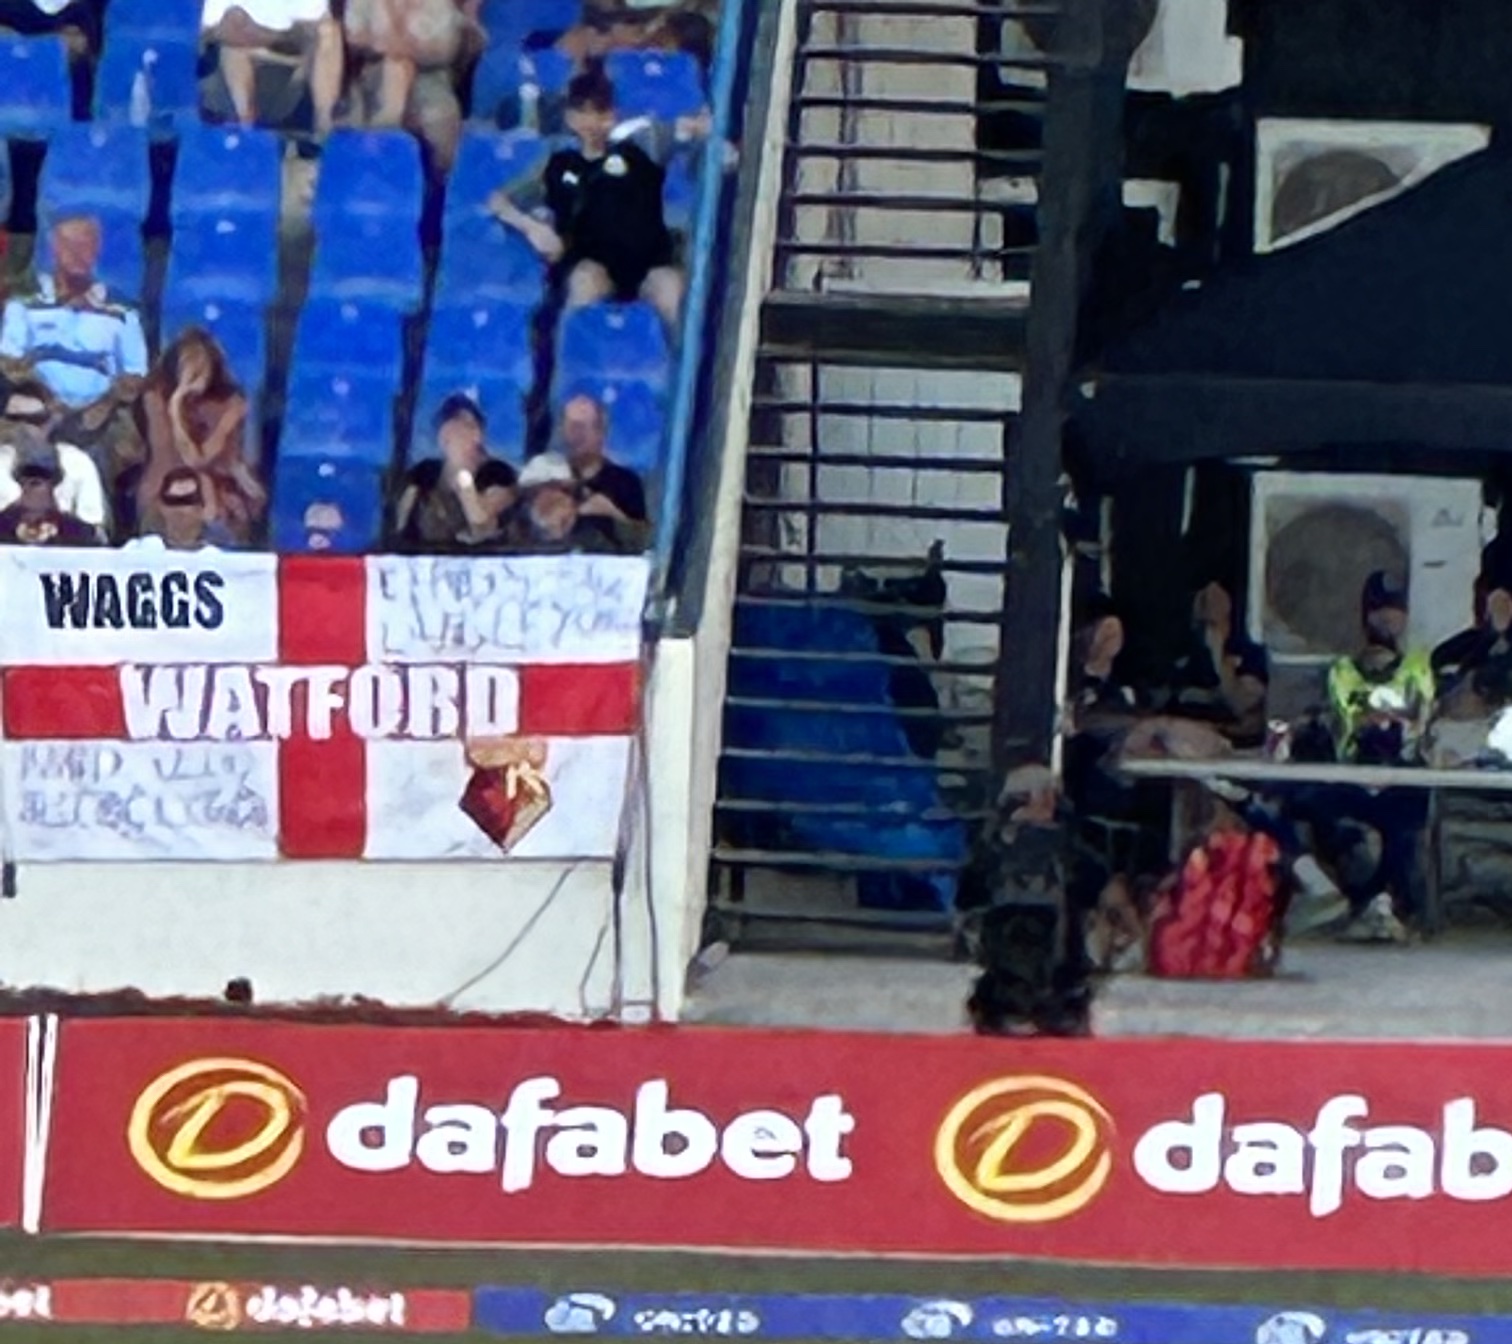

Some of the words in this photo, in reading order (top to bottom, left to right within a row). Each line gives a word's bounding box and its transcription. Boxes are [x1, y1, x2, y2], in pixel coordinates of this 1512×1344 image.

[39, 570, 225, 630] WAGGS
[118, 663, 522, 741] WATFORD
[325, 1074, 856, 1193] dafabet
